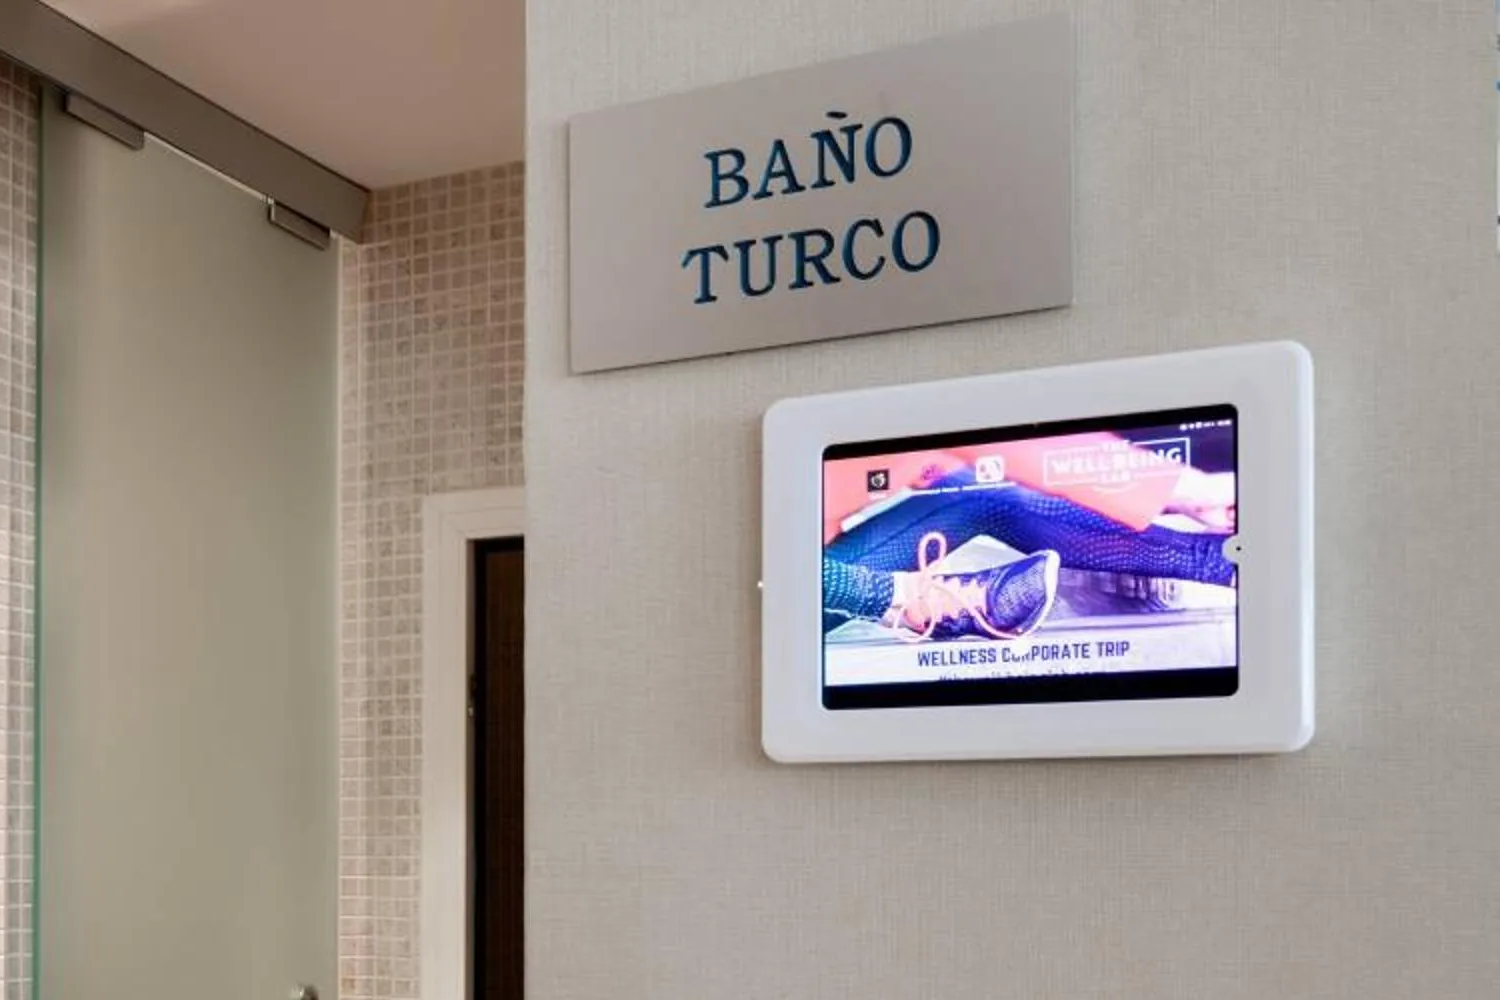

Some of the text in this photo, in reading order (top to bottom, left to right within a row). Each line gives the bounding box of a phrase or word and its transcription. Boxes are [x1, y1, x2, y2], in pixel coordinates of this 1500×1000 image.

[704, 110, 912, 208] BAÑO
[680, 210, 940, 304] TURCO
[917, 648, 997, 667] WELLNESS
[1097, 640, 1131, 658] TRIP
